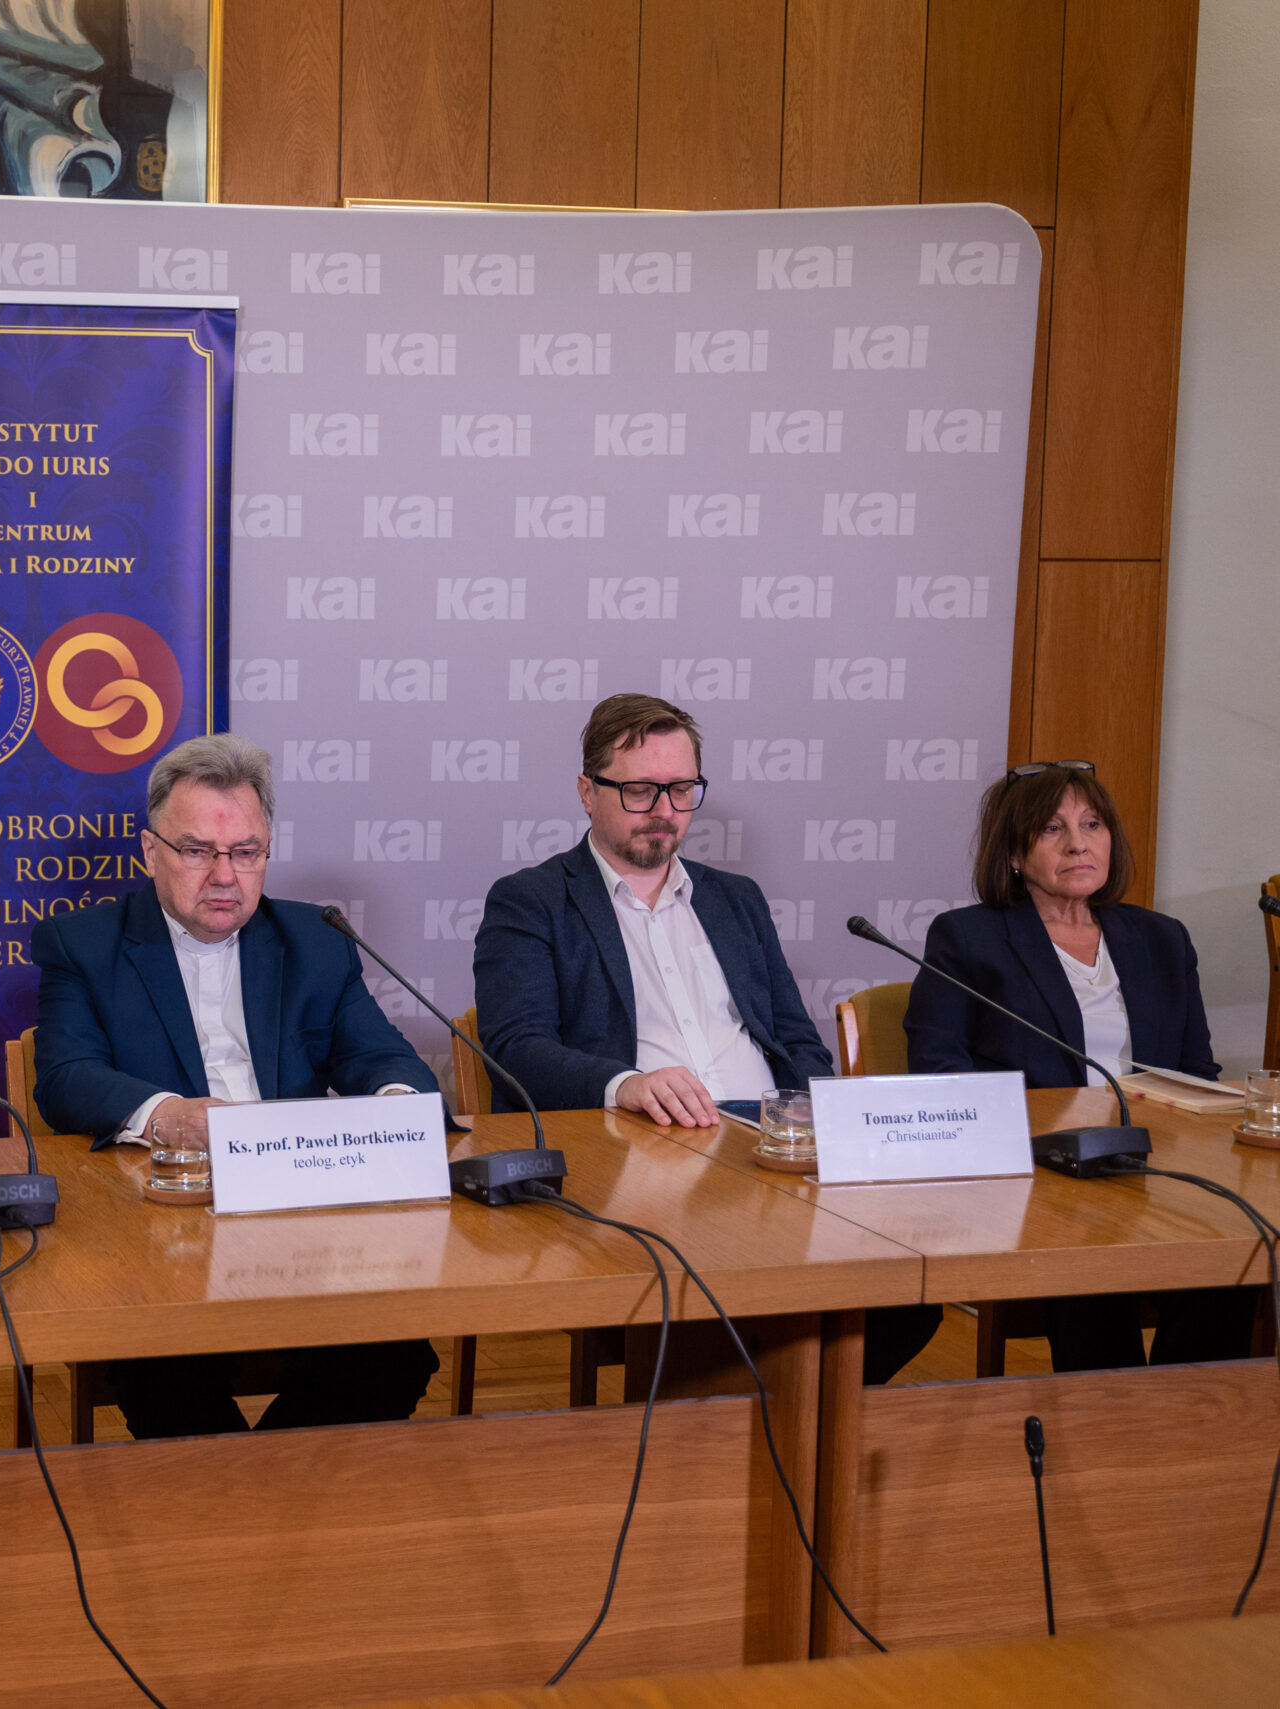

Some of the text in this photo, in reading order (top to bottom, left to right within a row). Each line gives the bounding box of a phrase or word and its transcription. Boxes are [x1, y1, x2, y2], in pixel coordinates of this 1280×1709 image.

[138, 246, 228, 291] kai
[290, 252, 380, 295] kai
[444, 254, 534, 295] kai
[599, 252, 691, 294] kai
[757, 245, 853, 290] kai
[920, 240, 1020, 287] kai
[366, 333, 456, 376] kai
[519, 333, 611, 376] kai
[675, 330, 768, 373] kai
[833, 325, 929, 370] kai
[289, 413, 379, 456] kai
[441, 414, 532, 458] kai
[594, 413, 686, 457] kai
[749, 410, 843, 454] kai
[906, 409, 1002, 453] kai
[42, 456, 110, 477] IURIS
[28, 491, 37, 508] I
[364, 495, 453, 538] kai
[515, 495, 605, 538] kai
[668, 494, 760, 537] kai
[823, 492, 916, 536] kai
[26, 555, 136, 575] RODZINY
[286, 577, 375, 620] kai
[437, 577, 526, 620] kai
[588, 577, 678, 620] kai
[741, 575, 833, 619] kai
[896, 575, 989, 619] kai
[15, 665, 34, 731] PRAWNEJ
[360, 659, 447, 701] kai
[509, 659, 598, 701] kai
[661, 658, 751, 701] kai
[814, 657, 906, 700] kai
[282, 740, 370, 782] kai
[432, 740, 519, 782] kai
[731, 739, 823, 782] kai
[886, 738, 979, 781] kai
[354, 820, 441, 862] kai
[679, 819, 742, 862] ai
[803, 819, 896, 862] kai
[16, 855, 154, 883] RODZIN
[424, 899, 484, 941] ka
[770, 898, 815, 941] ai
[861, 1107, 978, 1126] Tomasz Rowiński
[228, 1128, 426, 1156] Ks. prof. Paweł Bortkiewicz
[293, 1152, 366, 1170] teolog, etyk
[506, 1158, 553, 1177] BOSCH
